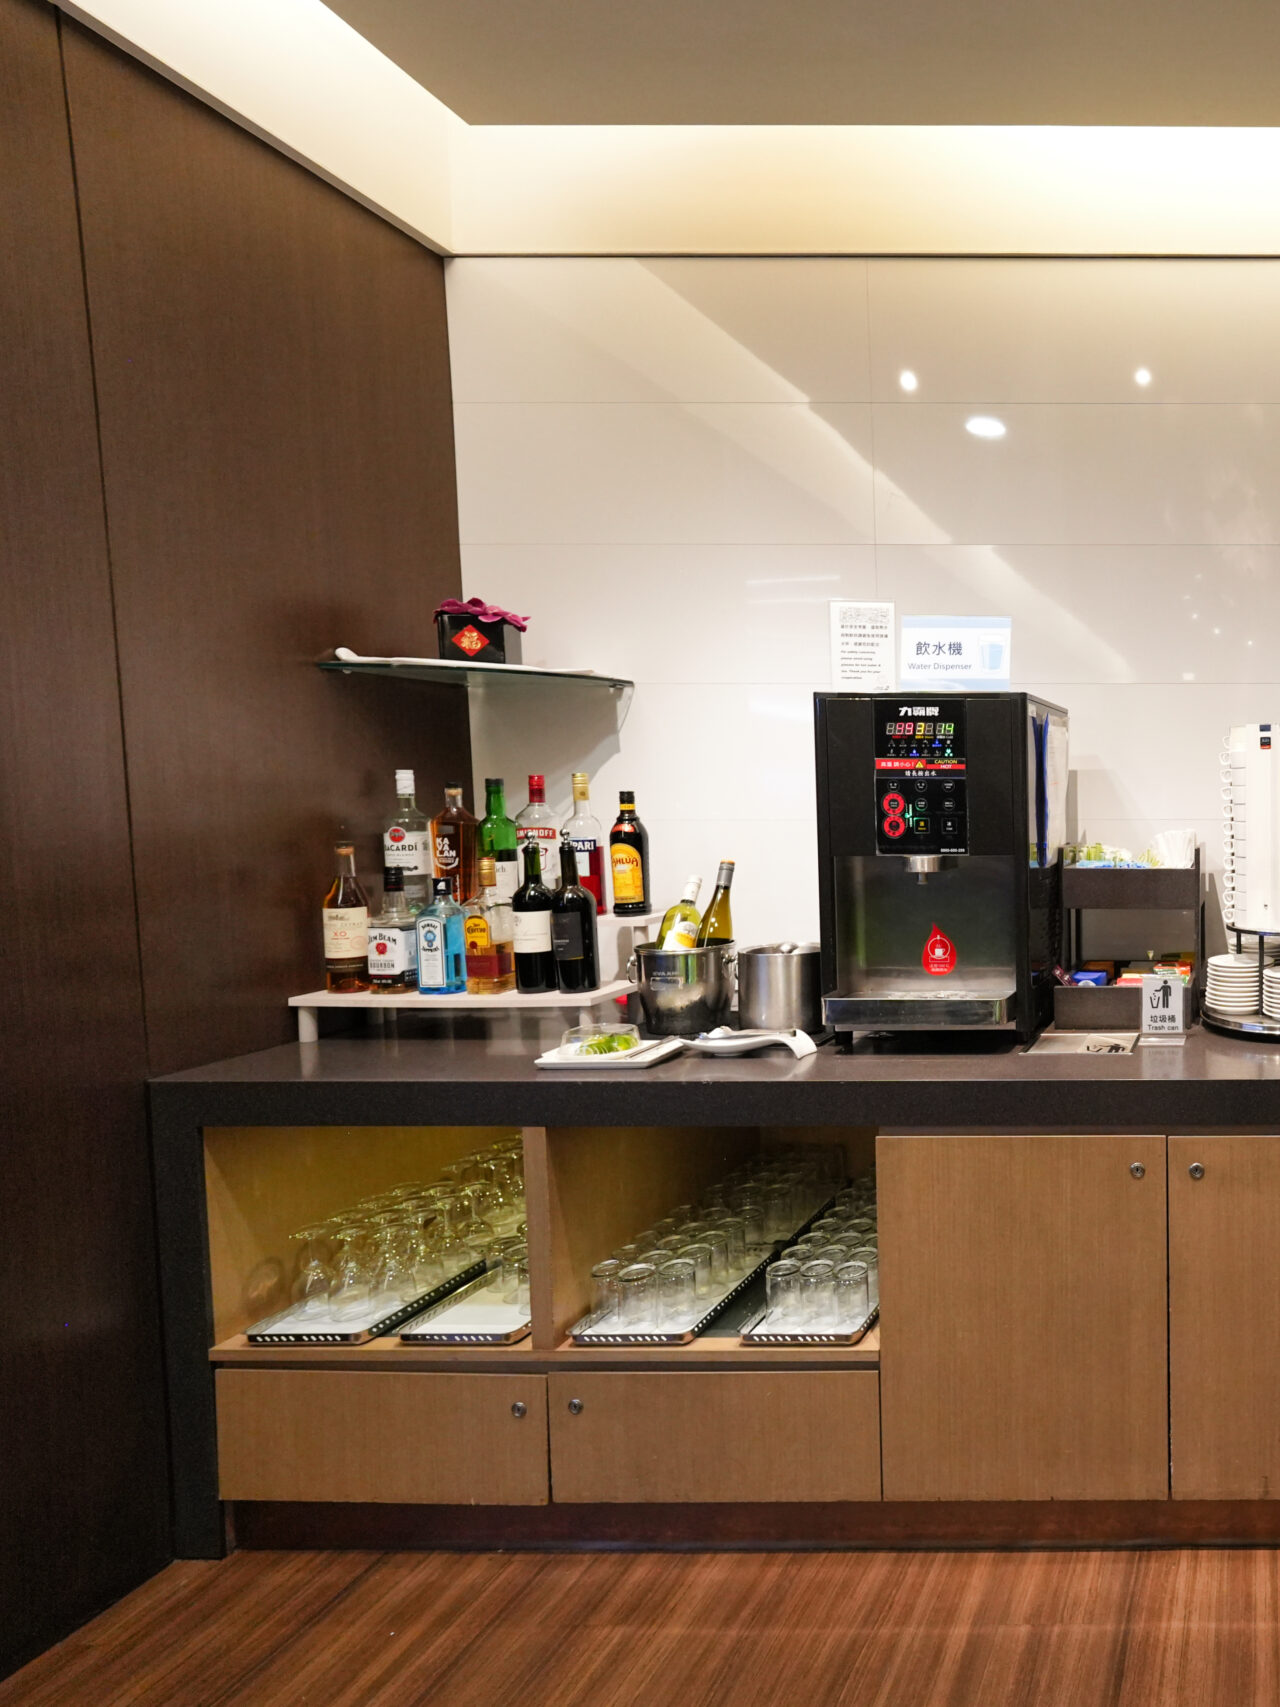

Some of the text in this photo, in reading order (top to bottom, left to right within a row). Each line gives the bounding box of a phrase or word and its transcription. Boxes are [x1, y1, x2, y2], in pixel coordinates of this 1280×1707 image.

[461, 631, 481, 649] 福
[916, 641, 963, 656] 飲水機
[933, 663, 972, 671] Dispenser
[516, 829, 553, 838] SMINOFF
[570, 840, 594, 851] PARI
[612, 857, 639, 867] AHLÚA
[1150, 1014, 1176, 1023] 垃圾桶
